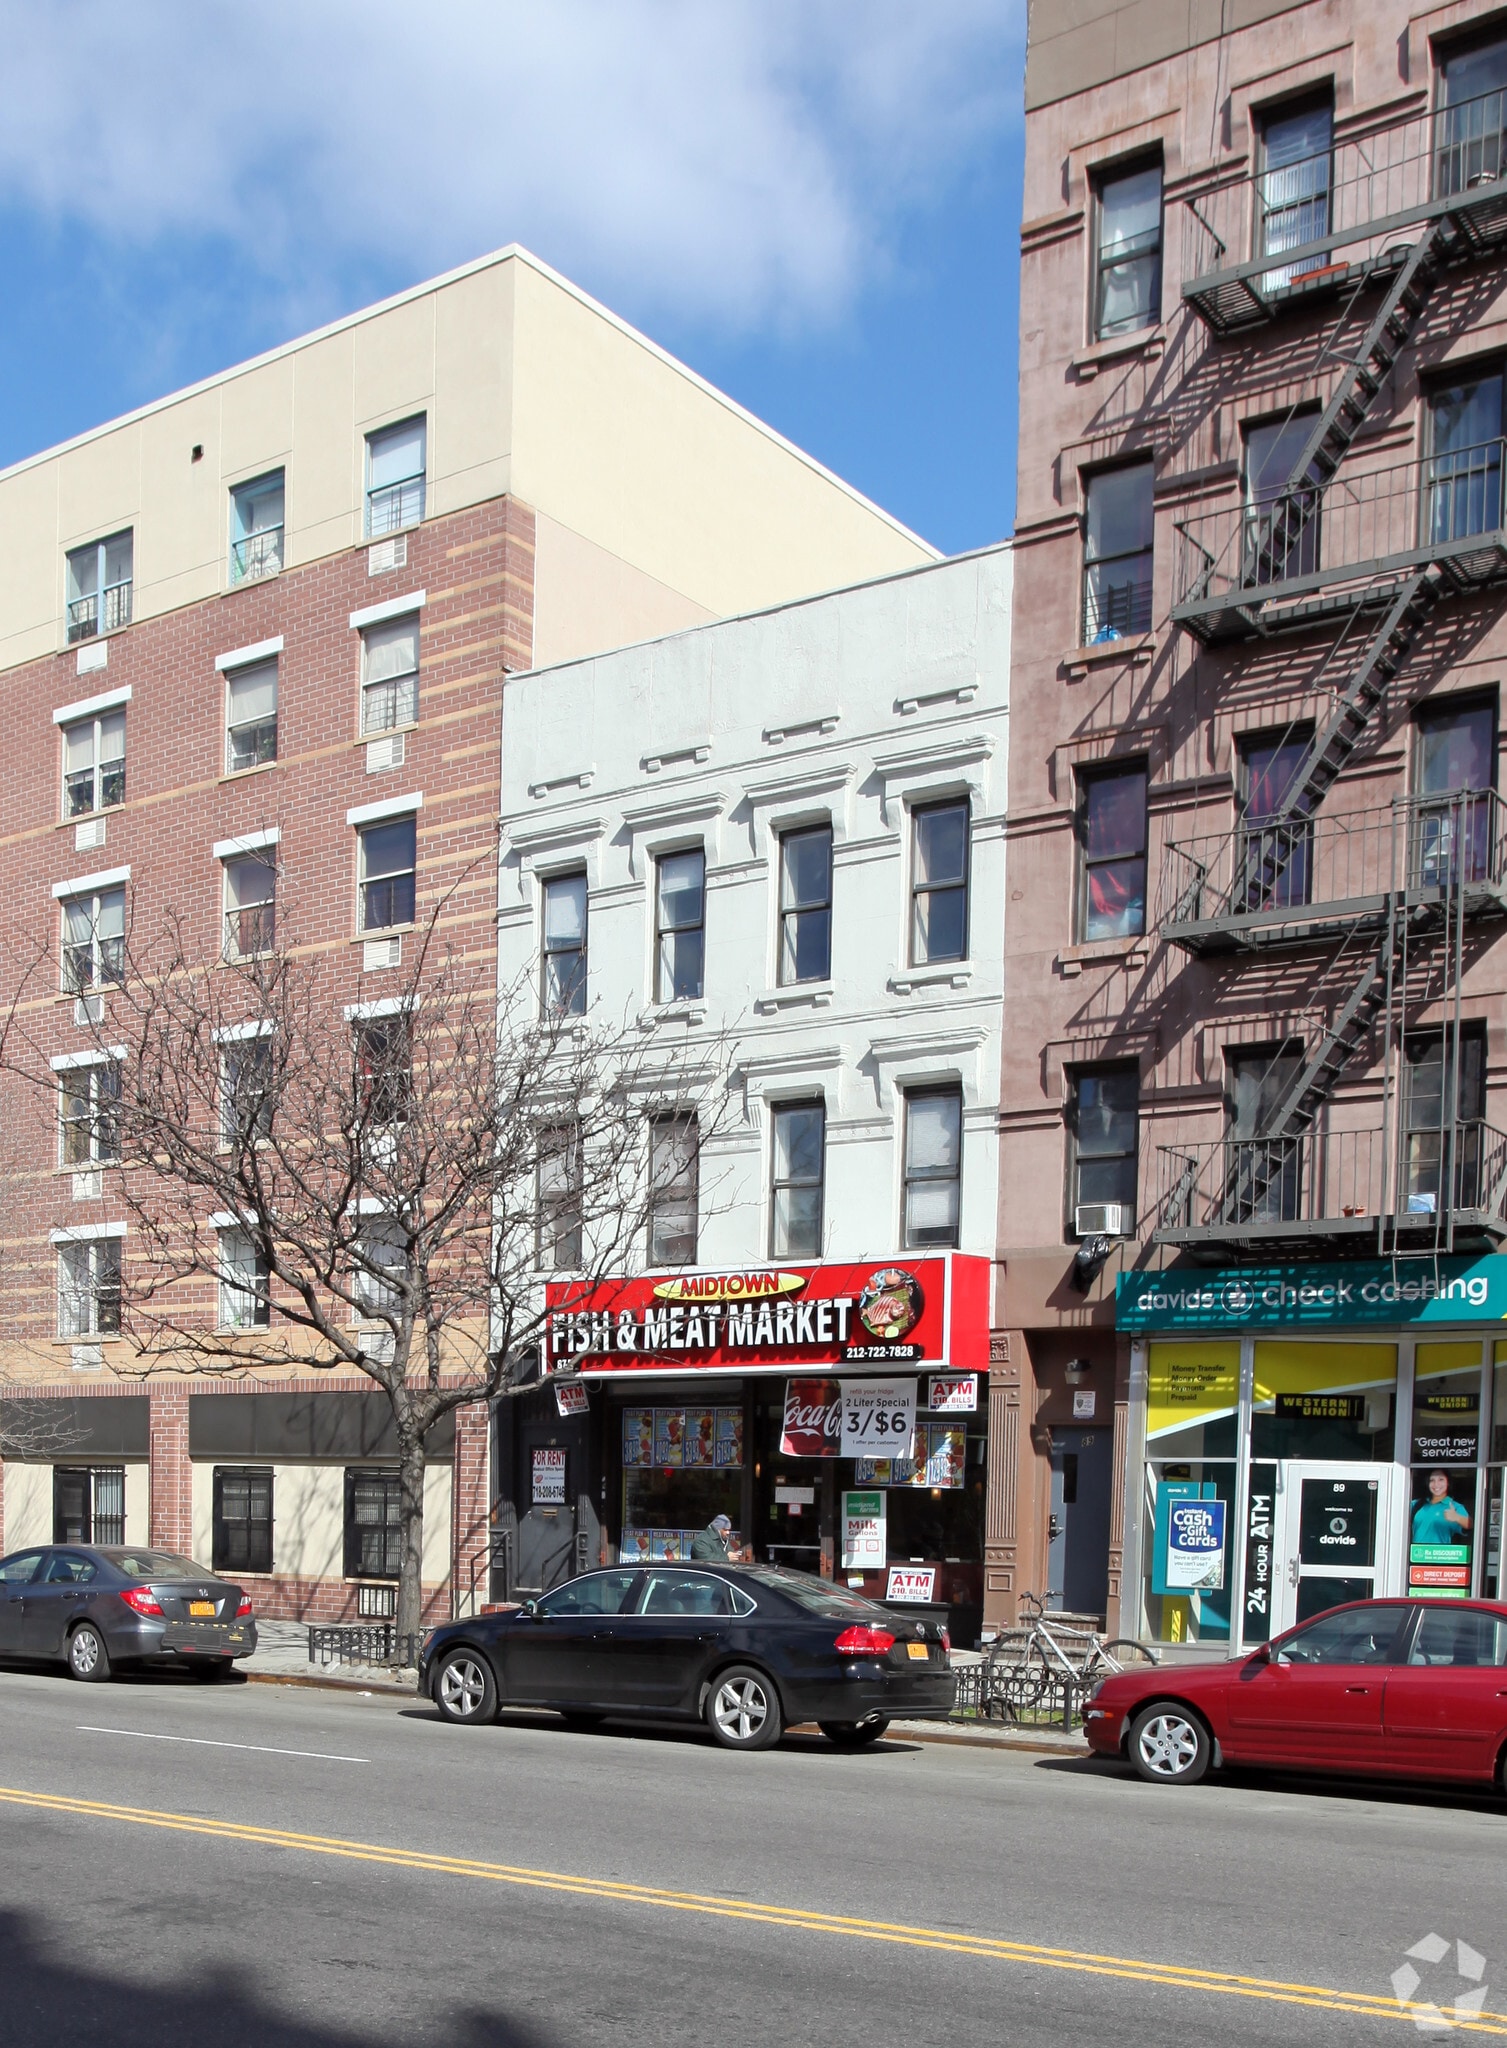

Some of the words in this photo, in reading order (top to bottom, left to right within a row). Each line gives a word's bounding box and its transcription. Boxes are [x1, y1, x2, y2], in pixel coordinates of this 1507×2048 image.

[680, 1273, 779, 1297] MIDTOWN
[1137, 1287, 1215, 1311] davids
[1262, 1279, 1354, 1306] check
[1361, 1274, 1489, 1306] cashing
[552, 1310, 610, 1354] FISH
[616, 1309, 638, 1350] &
[643, 1304, 722, 1350] MEAT
[727, 1297, 853, 1347] MARKET
[846, 1345, 914, 1359] 212-722-7828
[1172, 1365, 1195, 1373] Money
[1197, 1364, 1226, 1372] Transfer
[560, 1386, 585, 1402] ATM
[933, 1382, 972, 1395] ATM
[1171, 1384, 1206, 1392] Payments
[845, 1398, 851, 1406] 2
[853, 1398, 874, 1406] Liter
[876, 1397, 910, 1408] Special
[951, 1396, 971, 1404] BILLS
[1170, 1393, 1197, 1401] Prepaid
[1283, 1397, 1348, 1407] WESTERN
[1427, 1396, 1467, 1404] WESTERN
[1303, 1407, 1347, 1417] UNION
[846, 1409, 907, 1436] 3/$6
[1453, 1438, 1476, 1446] new
[532, 1449, 546, 1465] FOR
[547, 1449, 566, 1465] RENT
[1333, 1483, 1345, 1492] 89
[1173, 1510, 1213, 1526] Cash
[1250, 1495, 1271, 1539] ATM
[848, 1520, 878, 1530] Milk
[1187, 1525, 1208, 1536] Gift
[1178, 1533, 1218, 1547] Cards
[1319, 1535, 1357, 1545] davids
[1256, 1544, 1269, 1582] HOUR
[893, 1574, 930, 1588] ATM
[891, 1587, 908, 1595] $10.
[908, 1588, 928, 1596] BILLS
[1247, 1587, 1267, 1614] 24
